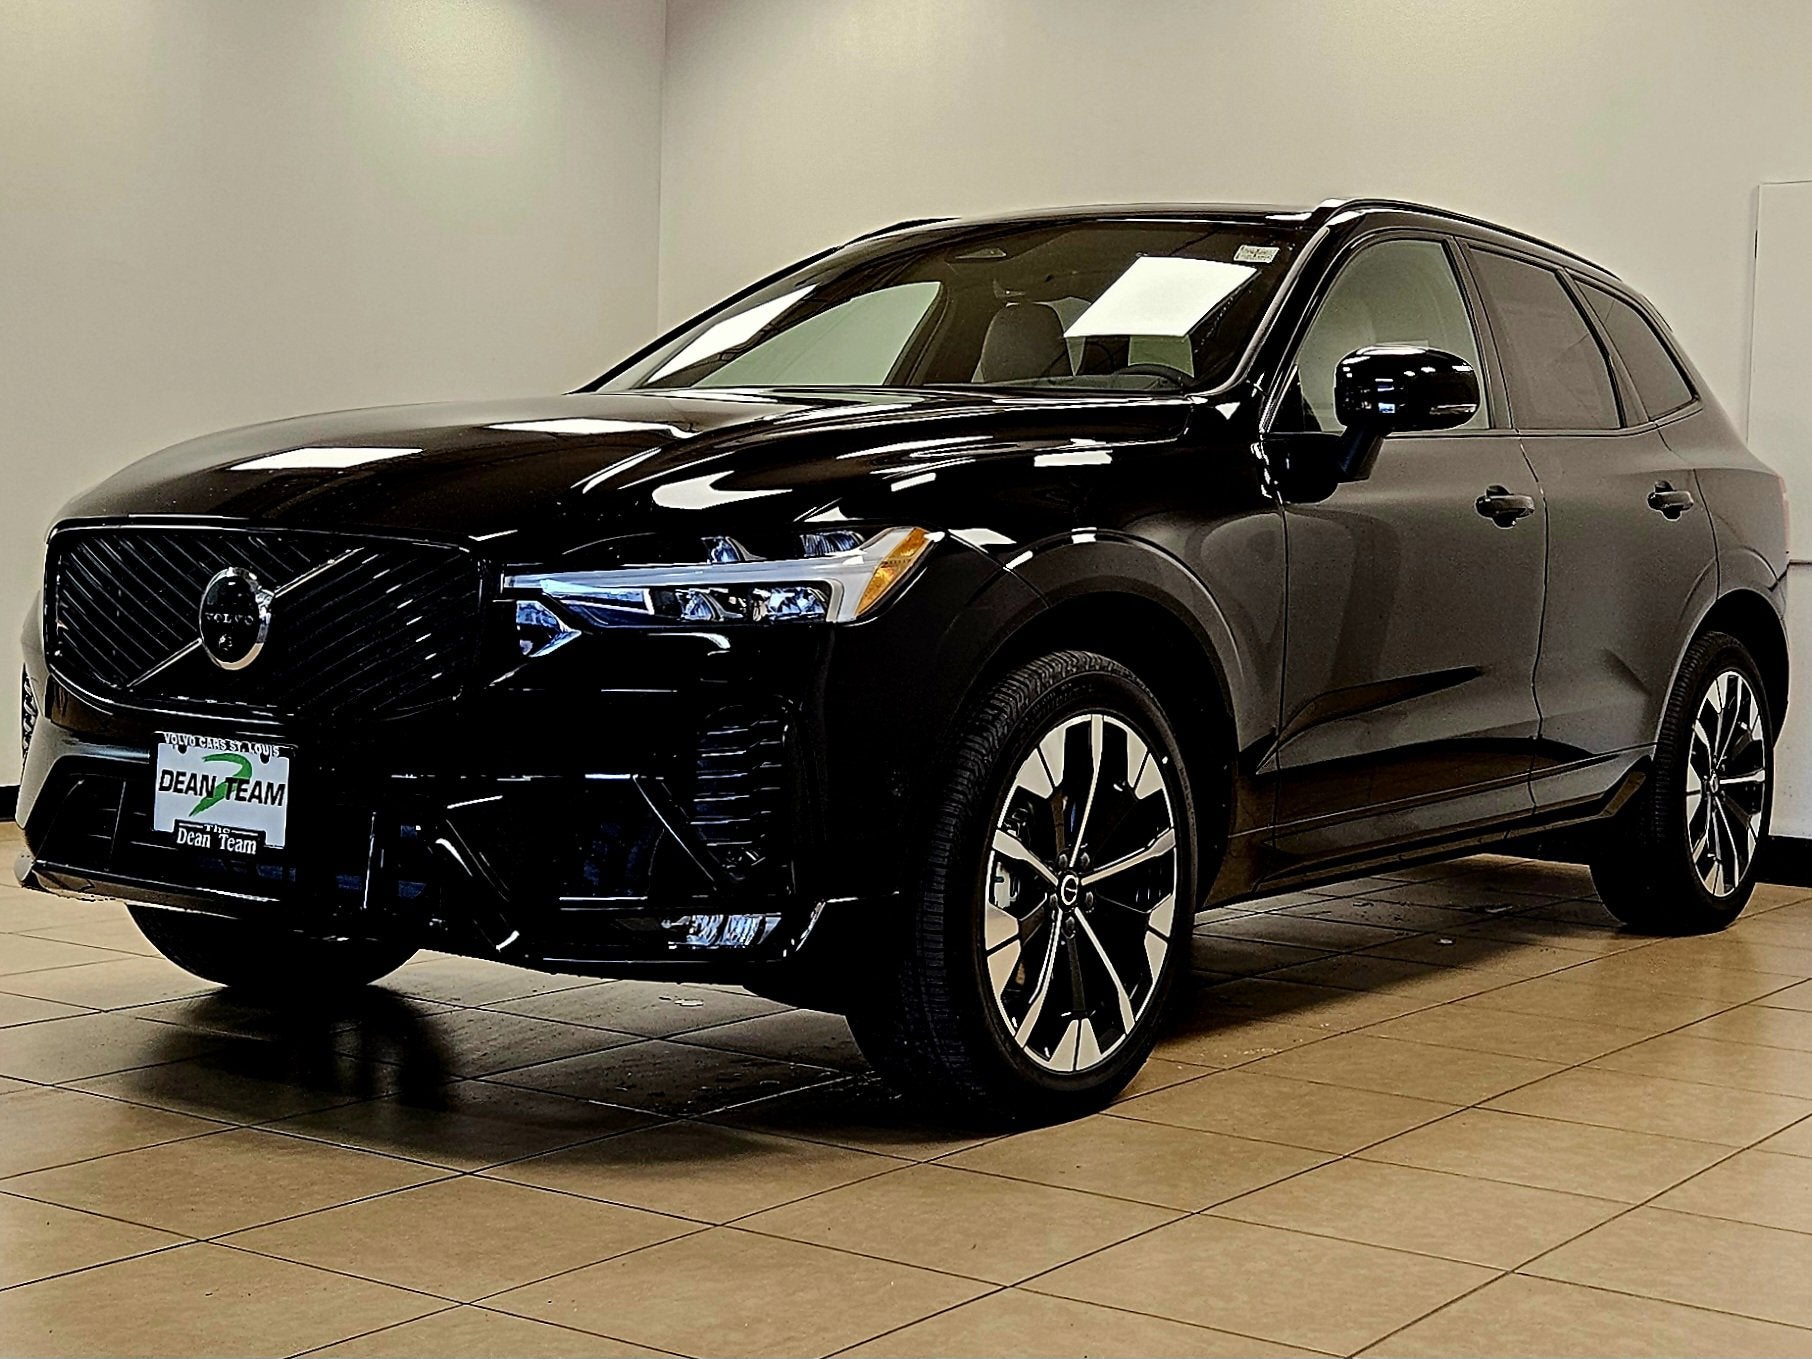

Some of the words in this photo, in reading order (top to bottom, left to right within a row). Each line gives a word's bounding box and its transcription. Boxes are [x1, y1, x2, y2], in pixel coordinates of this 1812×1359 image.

[205, 612, 254, 626] VOLVO
[164, 732, 196, 746] VOLVO
[199, 737, 227, 750] CARS
[229, 741, 246, 753] ST.
[249, 741, 280, 757] LOUIS
[158, 769, 217, 799] DEAN
[224, 776, 286, 807] TEAM
[176, 827, 211, 848] Dean
[218, 833, 257, 855] Team
[203, 823, 231, 834] The
